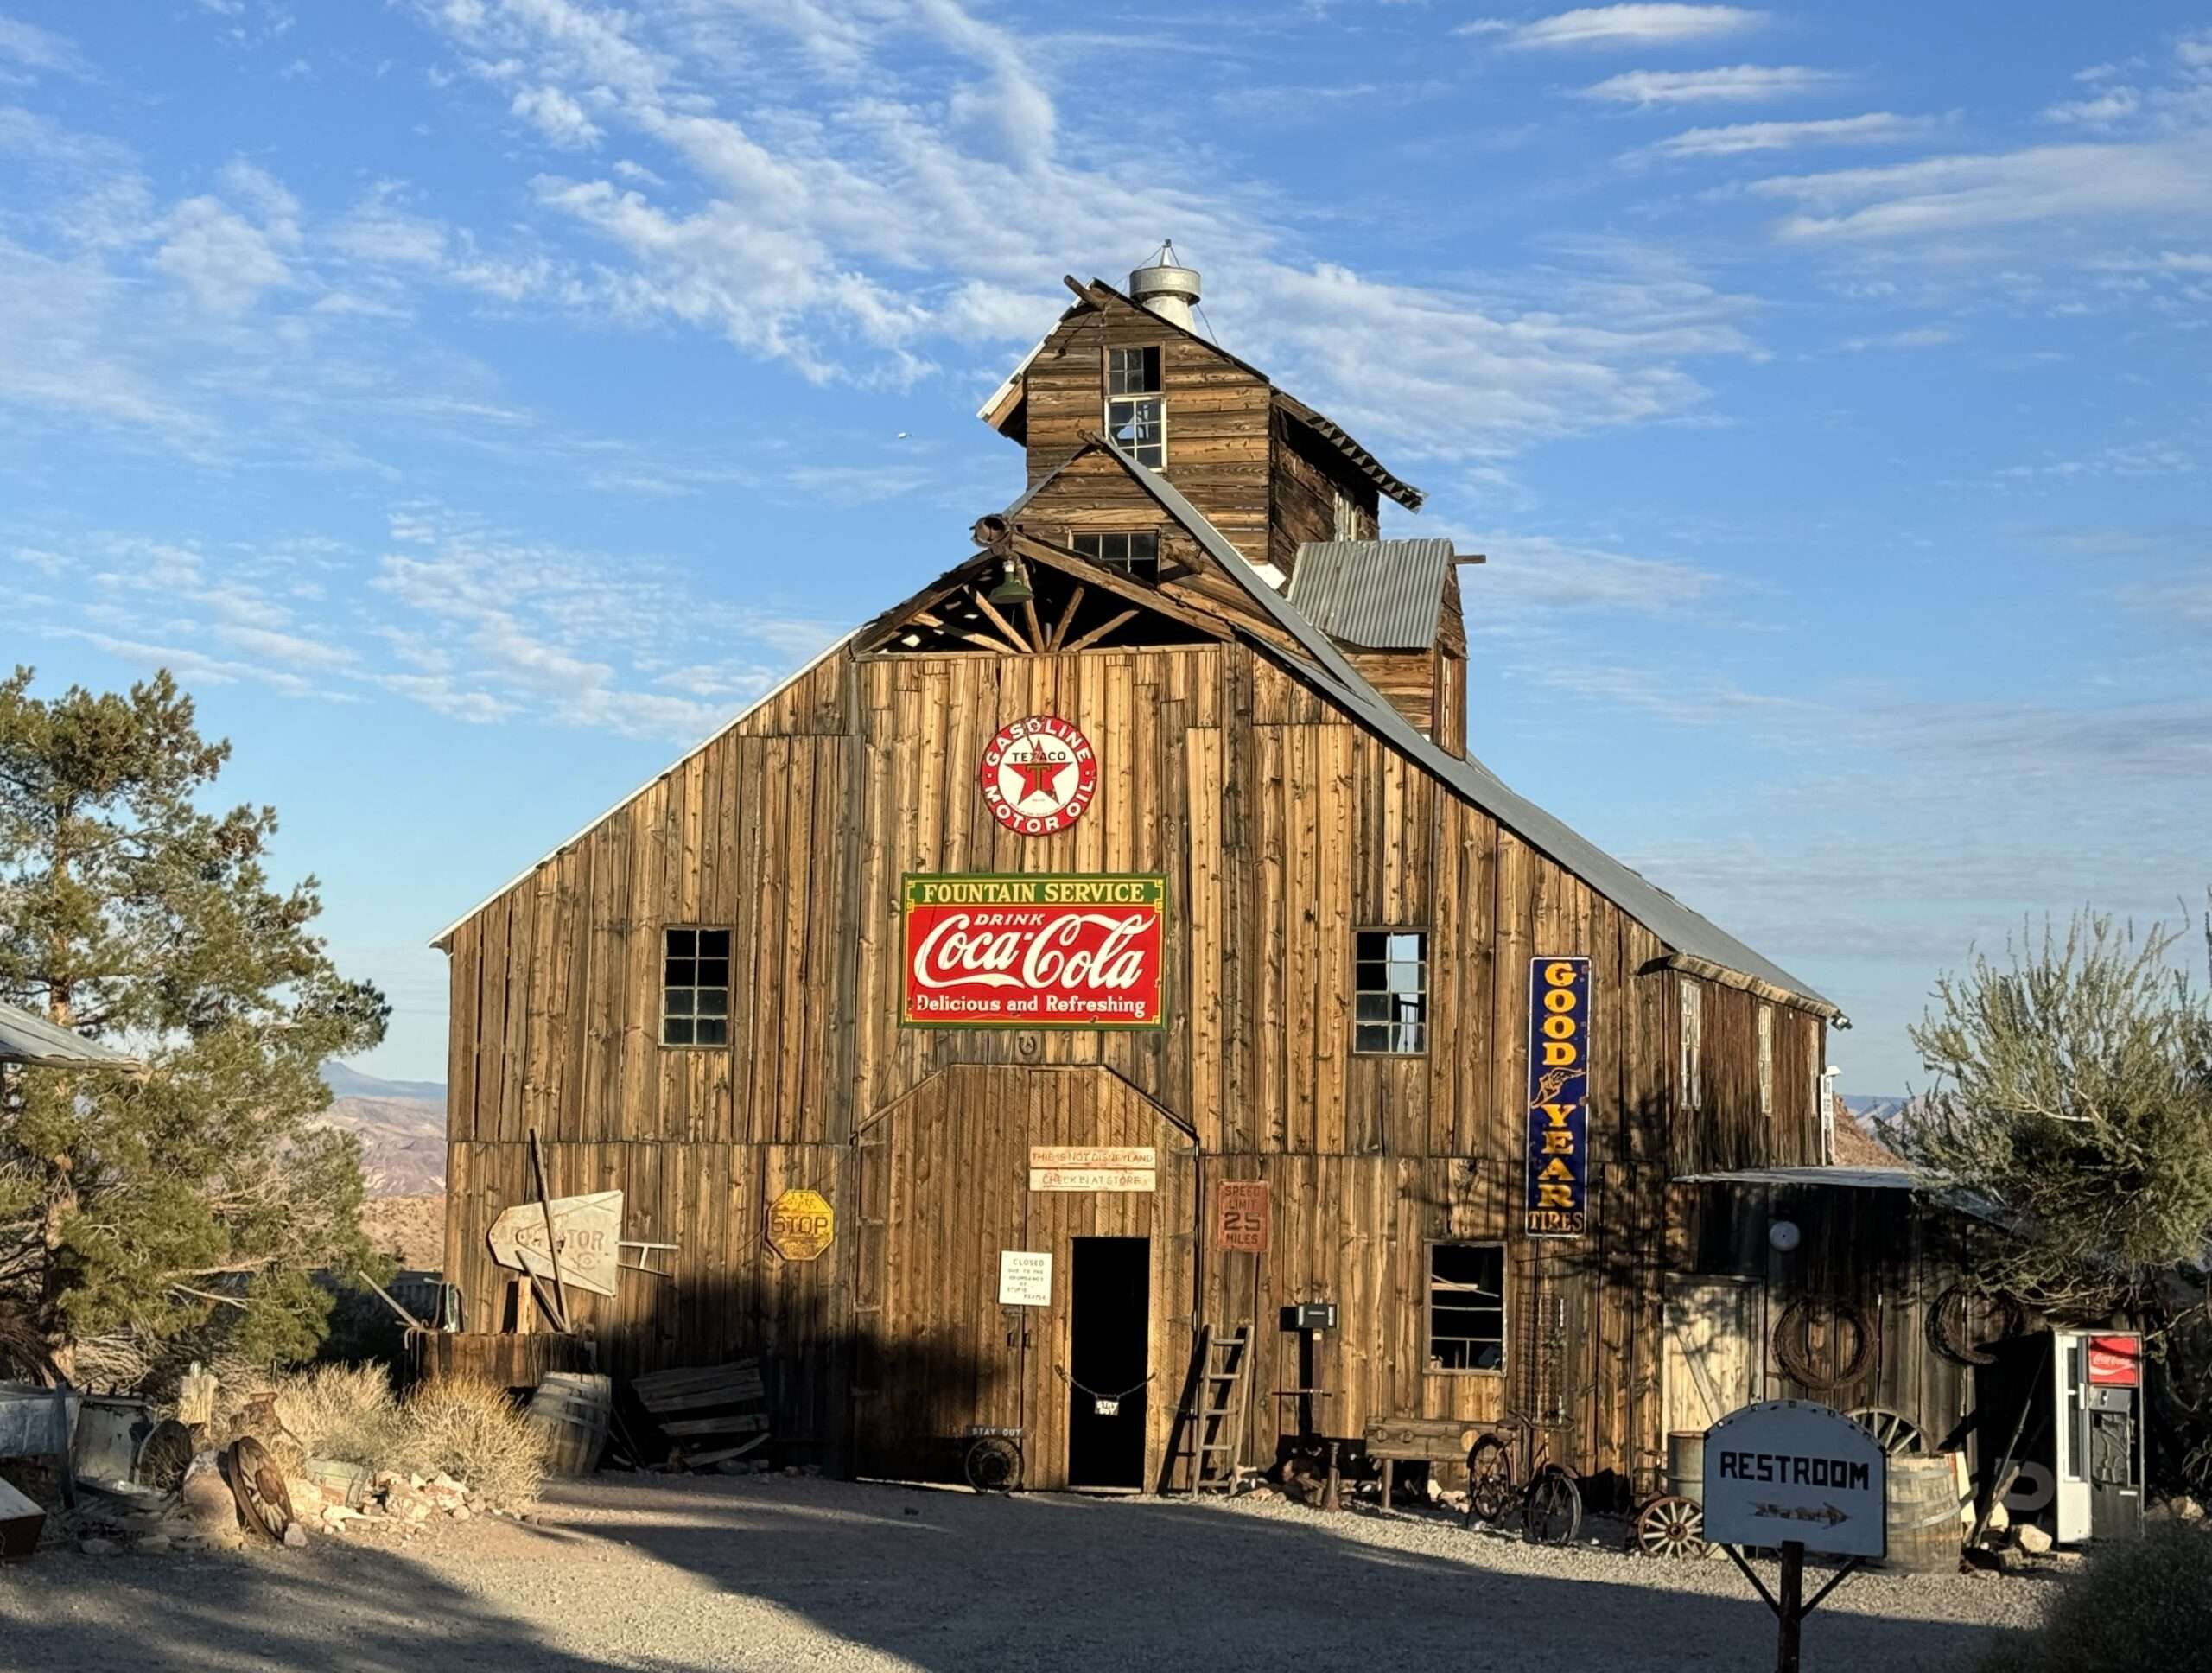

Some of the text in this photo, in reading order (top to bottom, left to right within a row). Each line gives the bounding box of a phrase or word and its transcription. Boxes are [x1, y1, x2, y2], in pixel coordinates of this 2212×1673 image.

[986, 718, 1092, 767] GASOLINE
[1012, 751, 1066, 762] TEXACO
[985, 780, 1094, 832] MOTOR OIL
[923, 883, 1145, 904] FOUNTAIN SERVICE
[974, 913, 1046, 926] DRINK
[917, 995, 1146, 1018] Delicious and Refreshing
[1056, 1152, 1066, 1162] IS
[1068, 1152, 1089, 1162] NOT
[1091, 1152, 1154, 1163] DISNEYLAND
[1042, 1173, 1077, 1185] CHECK
[1078, 1174, 1090, 1185] IN
[1091, 1175, 1104, 1186] AT
[1224, 1186, 1260, 1197] SPEED
[1229, 1199, 1256, 1210] LIMIT
[773, 1216, 829, 1235] STOP
[1224, 1212, 1261, 1231] 25
[1529, 1211, 1584, 1231] TIRES
[1225, 1233, 1259, 1245] MILES
[1013, 1258, 1045, 1267] CLOSED
[972, 1427, 1022, 1437] STAY OUT
[1719, 1451, 1869, 1491] RESTROOM
